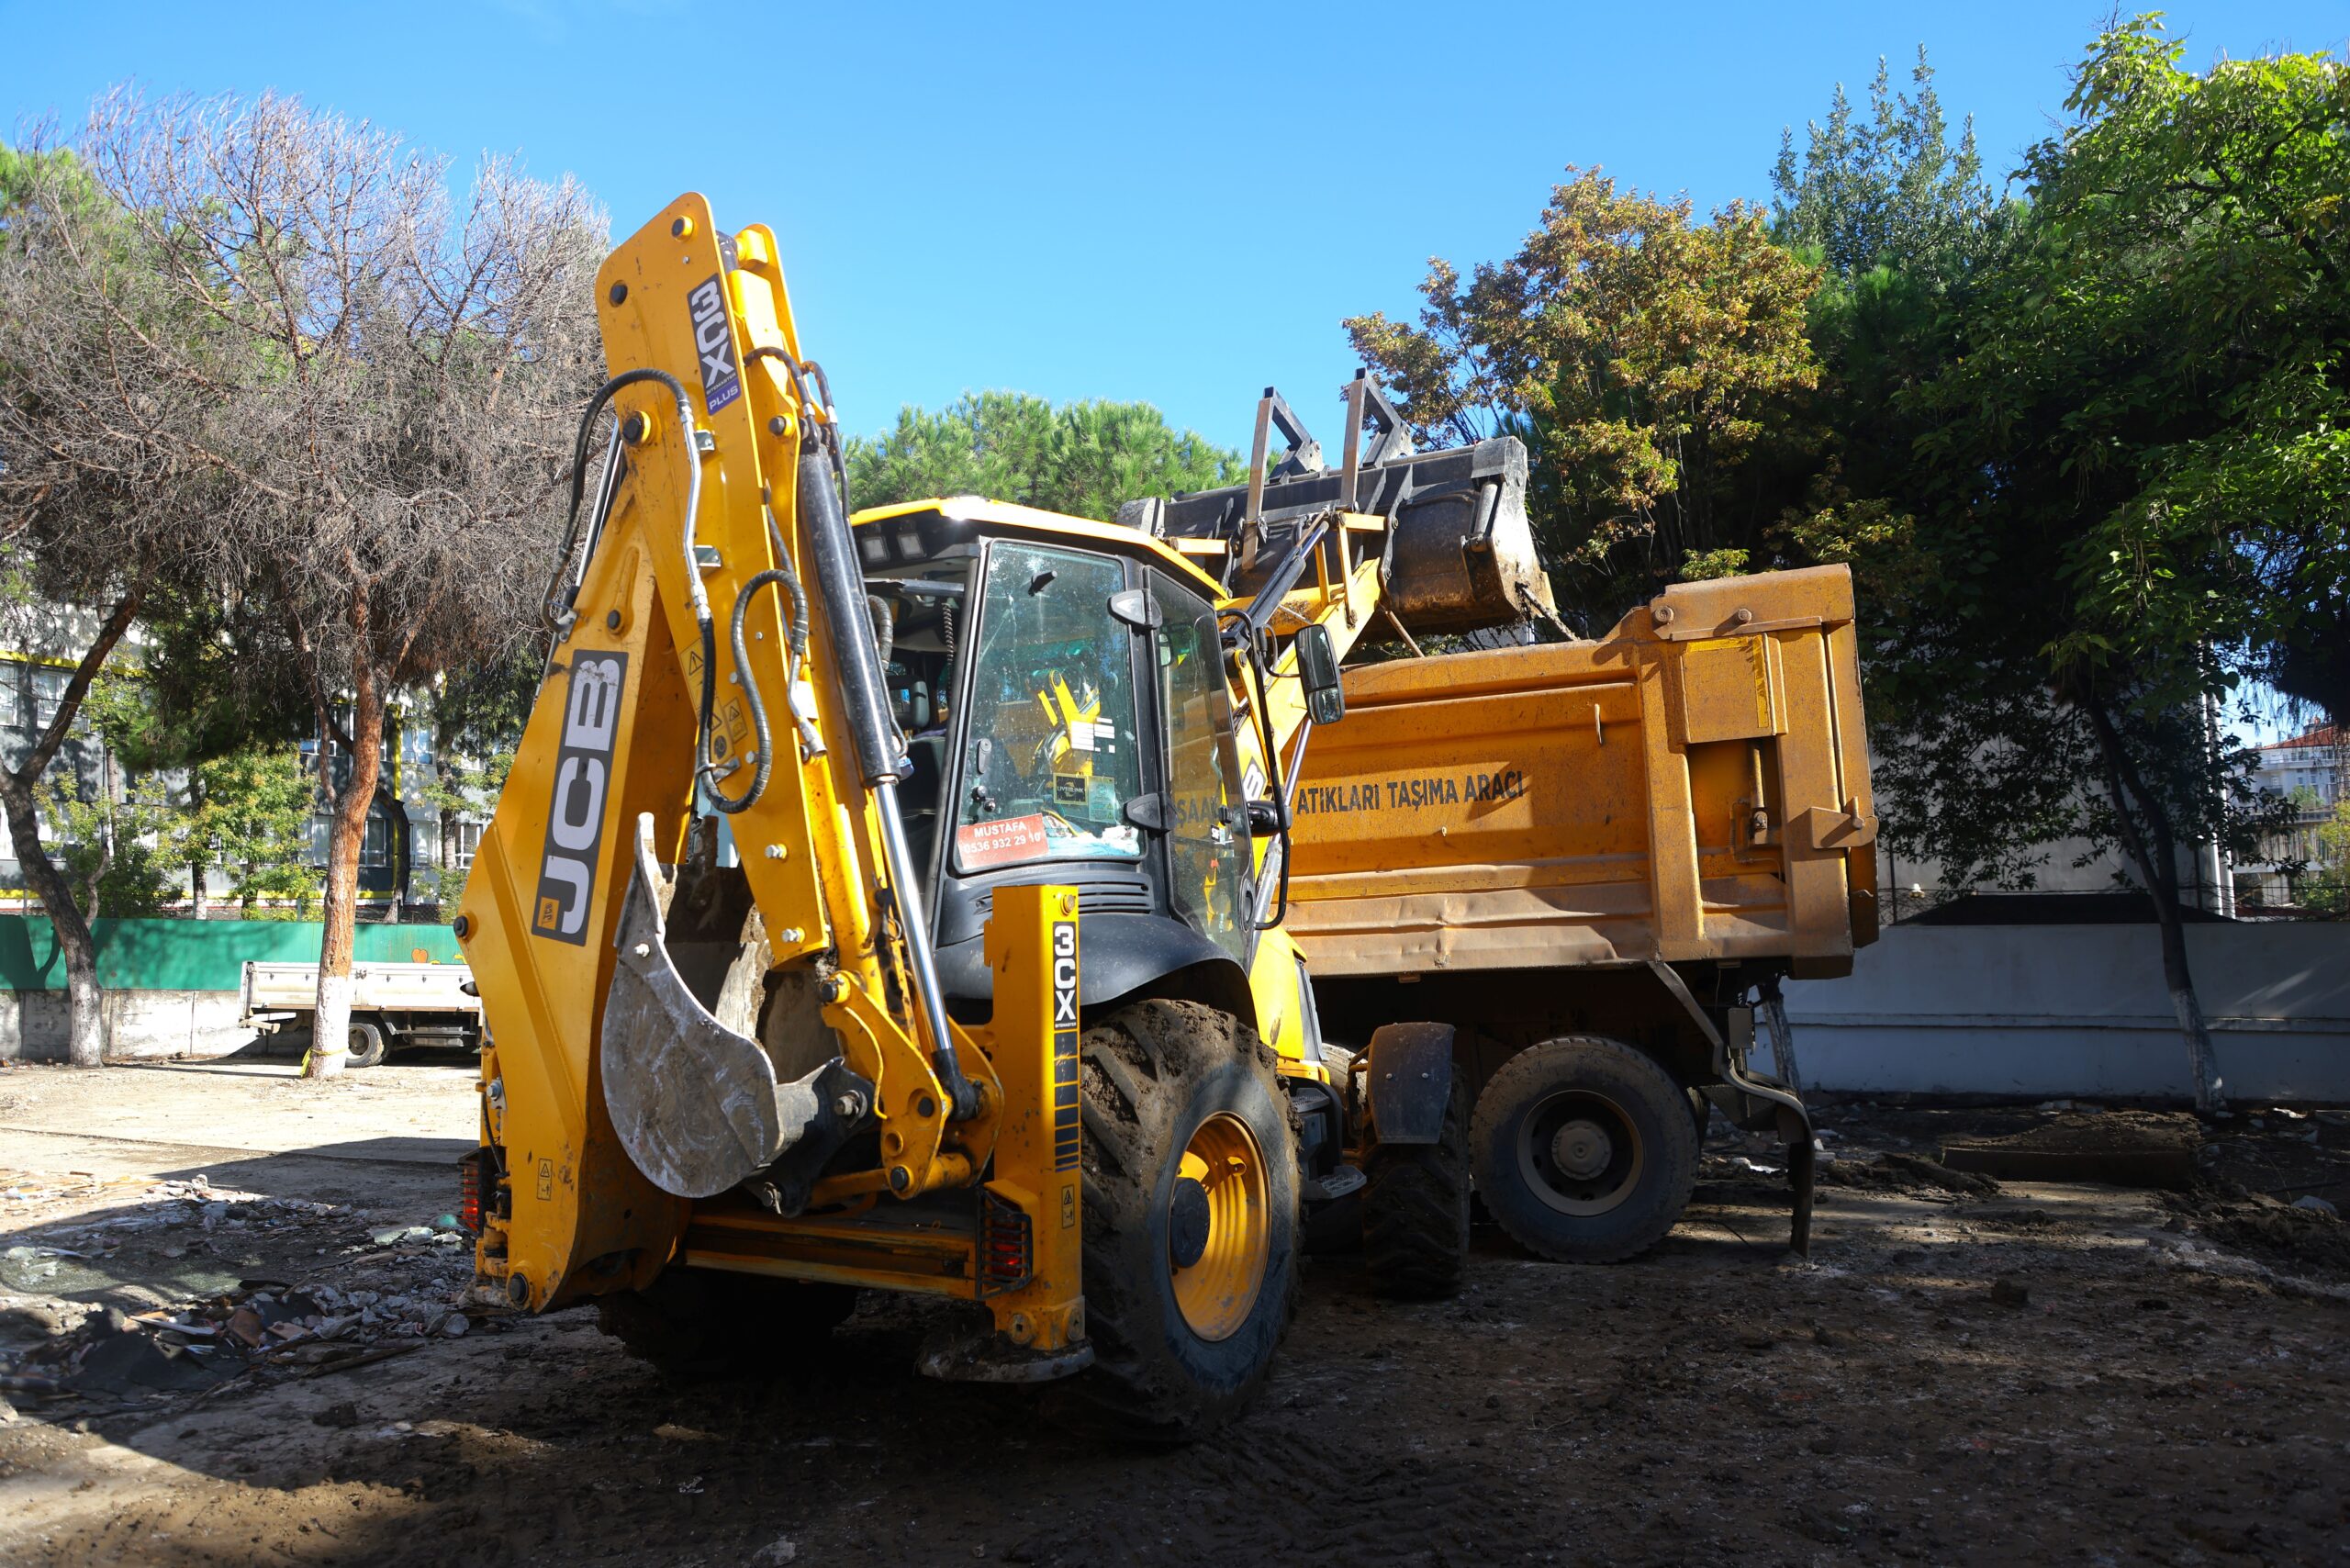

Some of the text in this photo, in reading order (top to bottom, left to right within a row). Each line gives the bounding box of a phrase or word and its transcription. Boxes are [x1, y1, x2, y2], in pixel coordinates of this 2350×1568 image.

[691, 280, 735, 388] 3CX
[706, 373, 737, 395] SITEMASTER
[709, 385, 739, 410] PLUS
[545, 659, 621, 935] JCB
[1296, 783, 1381, 815] ATIKLARI
[1386, 778, 1460, 812] TAŞIMA
[1463, 770, 1525, 803] ARACI
[963, 840, 990, 854] 0536
[992, 836, 1012, 849] 932
[1013, 834, 1026, 846] 29
[974, 821, 1027, 838] MUSTAFA
[1054, 924, 1077, 1022] 3CX
